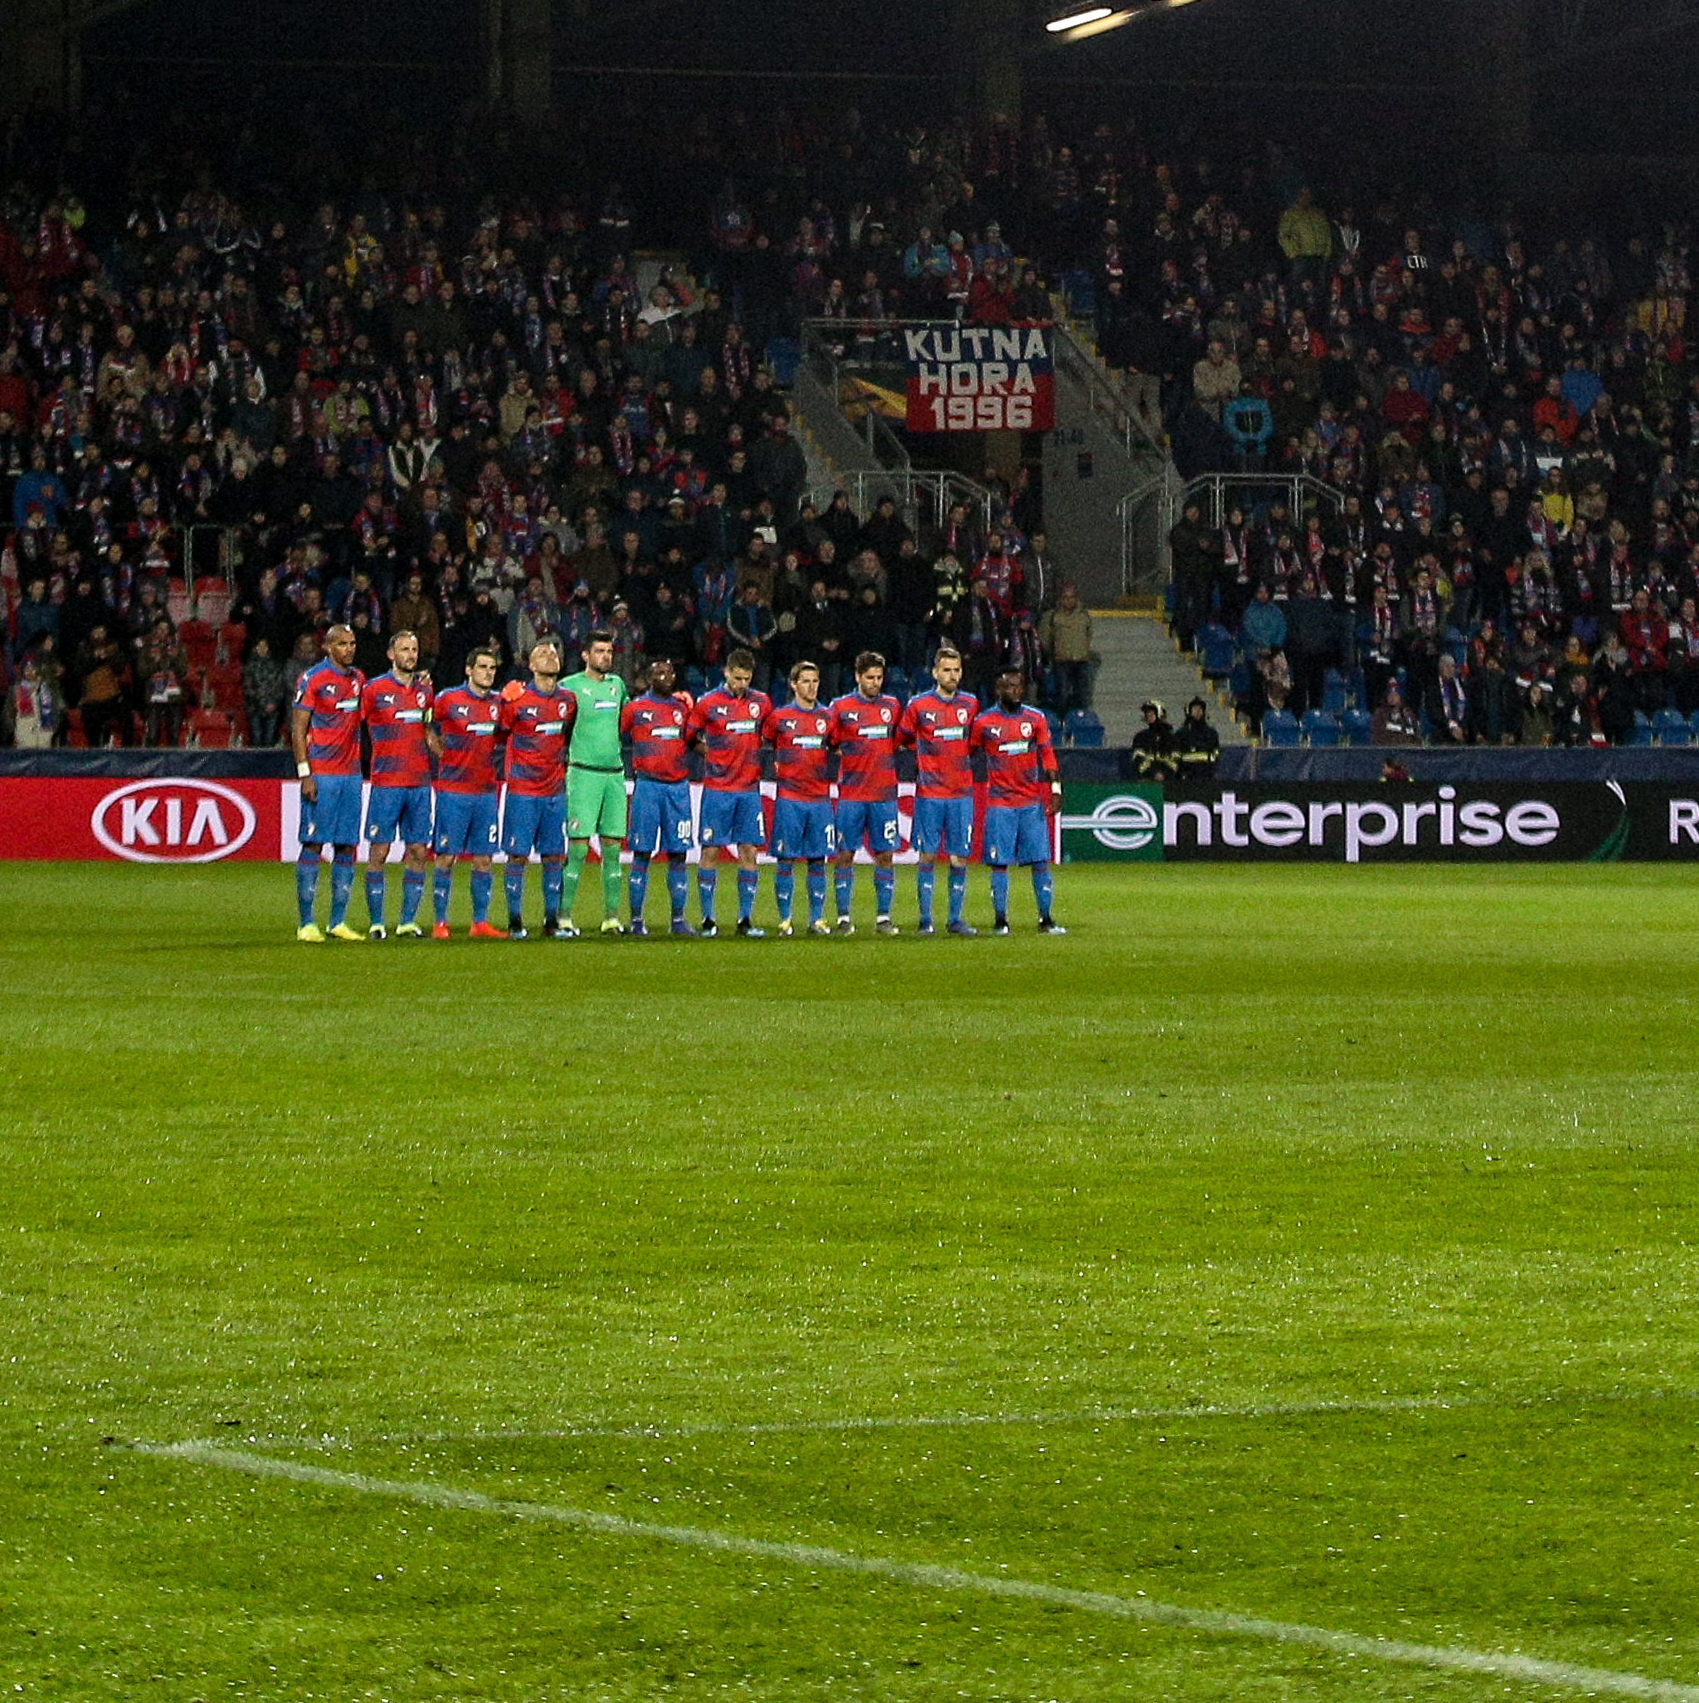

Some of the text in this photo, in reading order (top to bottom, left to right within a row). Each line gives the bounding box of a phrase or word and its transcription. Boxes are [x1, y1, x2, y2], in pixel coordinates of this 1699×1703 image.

[904, 327, 1049, 363] KUTNA
[918, 362, 1037, 395] HORA
[930, 396, 1033, 430] 1996
[121, 797, 228, 846] KIA
[1090, 785, 1560, 862] enterprise
